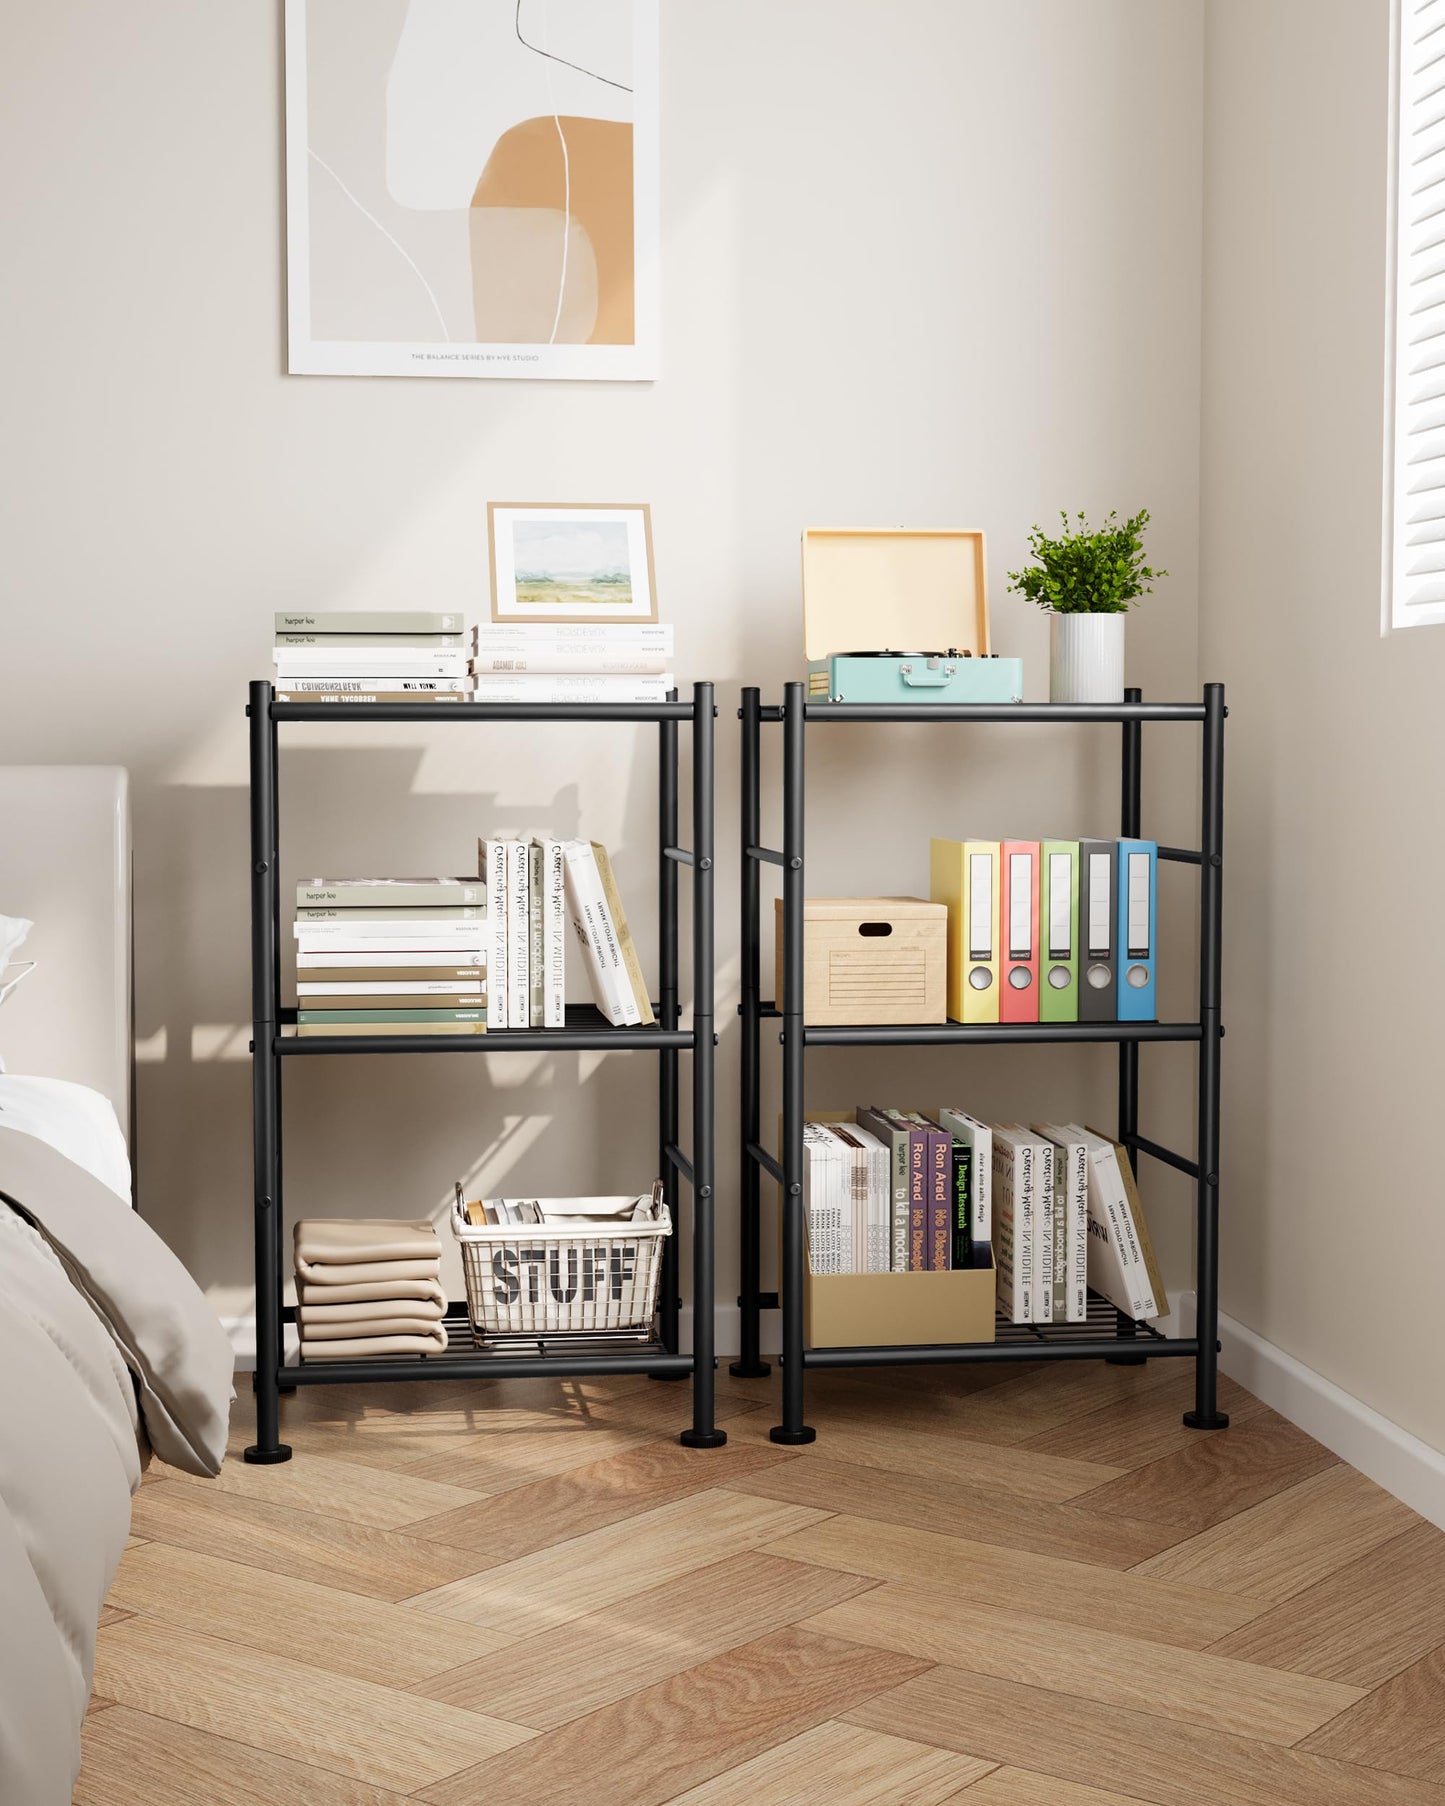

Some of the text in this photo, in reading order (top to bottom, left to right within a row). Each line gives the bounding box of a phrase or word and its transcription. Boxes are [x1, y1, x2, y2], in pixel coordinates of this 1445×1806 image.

[285, 617, 304, 626] harper
[306, 892, 326, 901] harper
[897, 1144, 907, 1164] harper
[913, 1143, 923, 1168] Ron
[935, 1144, 947, 1168] Ron
[899, 1165, 907, 1176] lee
[956, 1164, 967, 1191] Design
[896, 1187, 906, 1199] to
[913, 1171, 923, 1200] Arad
[935, 1171, 947, 1201] Arad
[896, 1202, 910, 1215] kill
[913, 1209, 924, 1227] No
[935, 1209, 947, 1227] No
[958, 1193, 967, 1229] Research
[492, 1248, 634, 1304] STUFF
